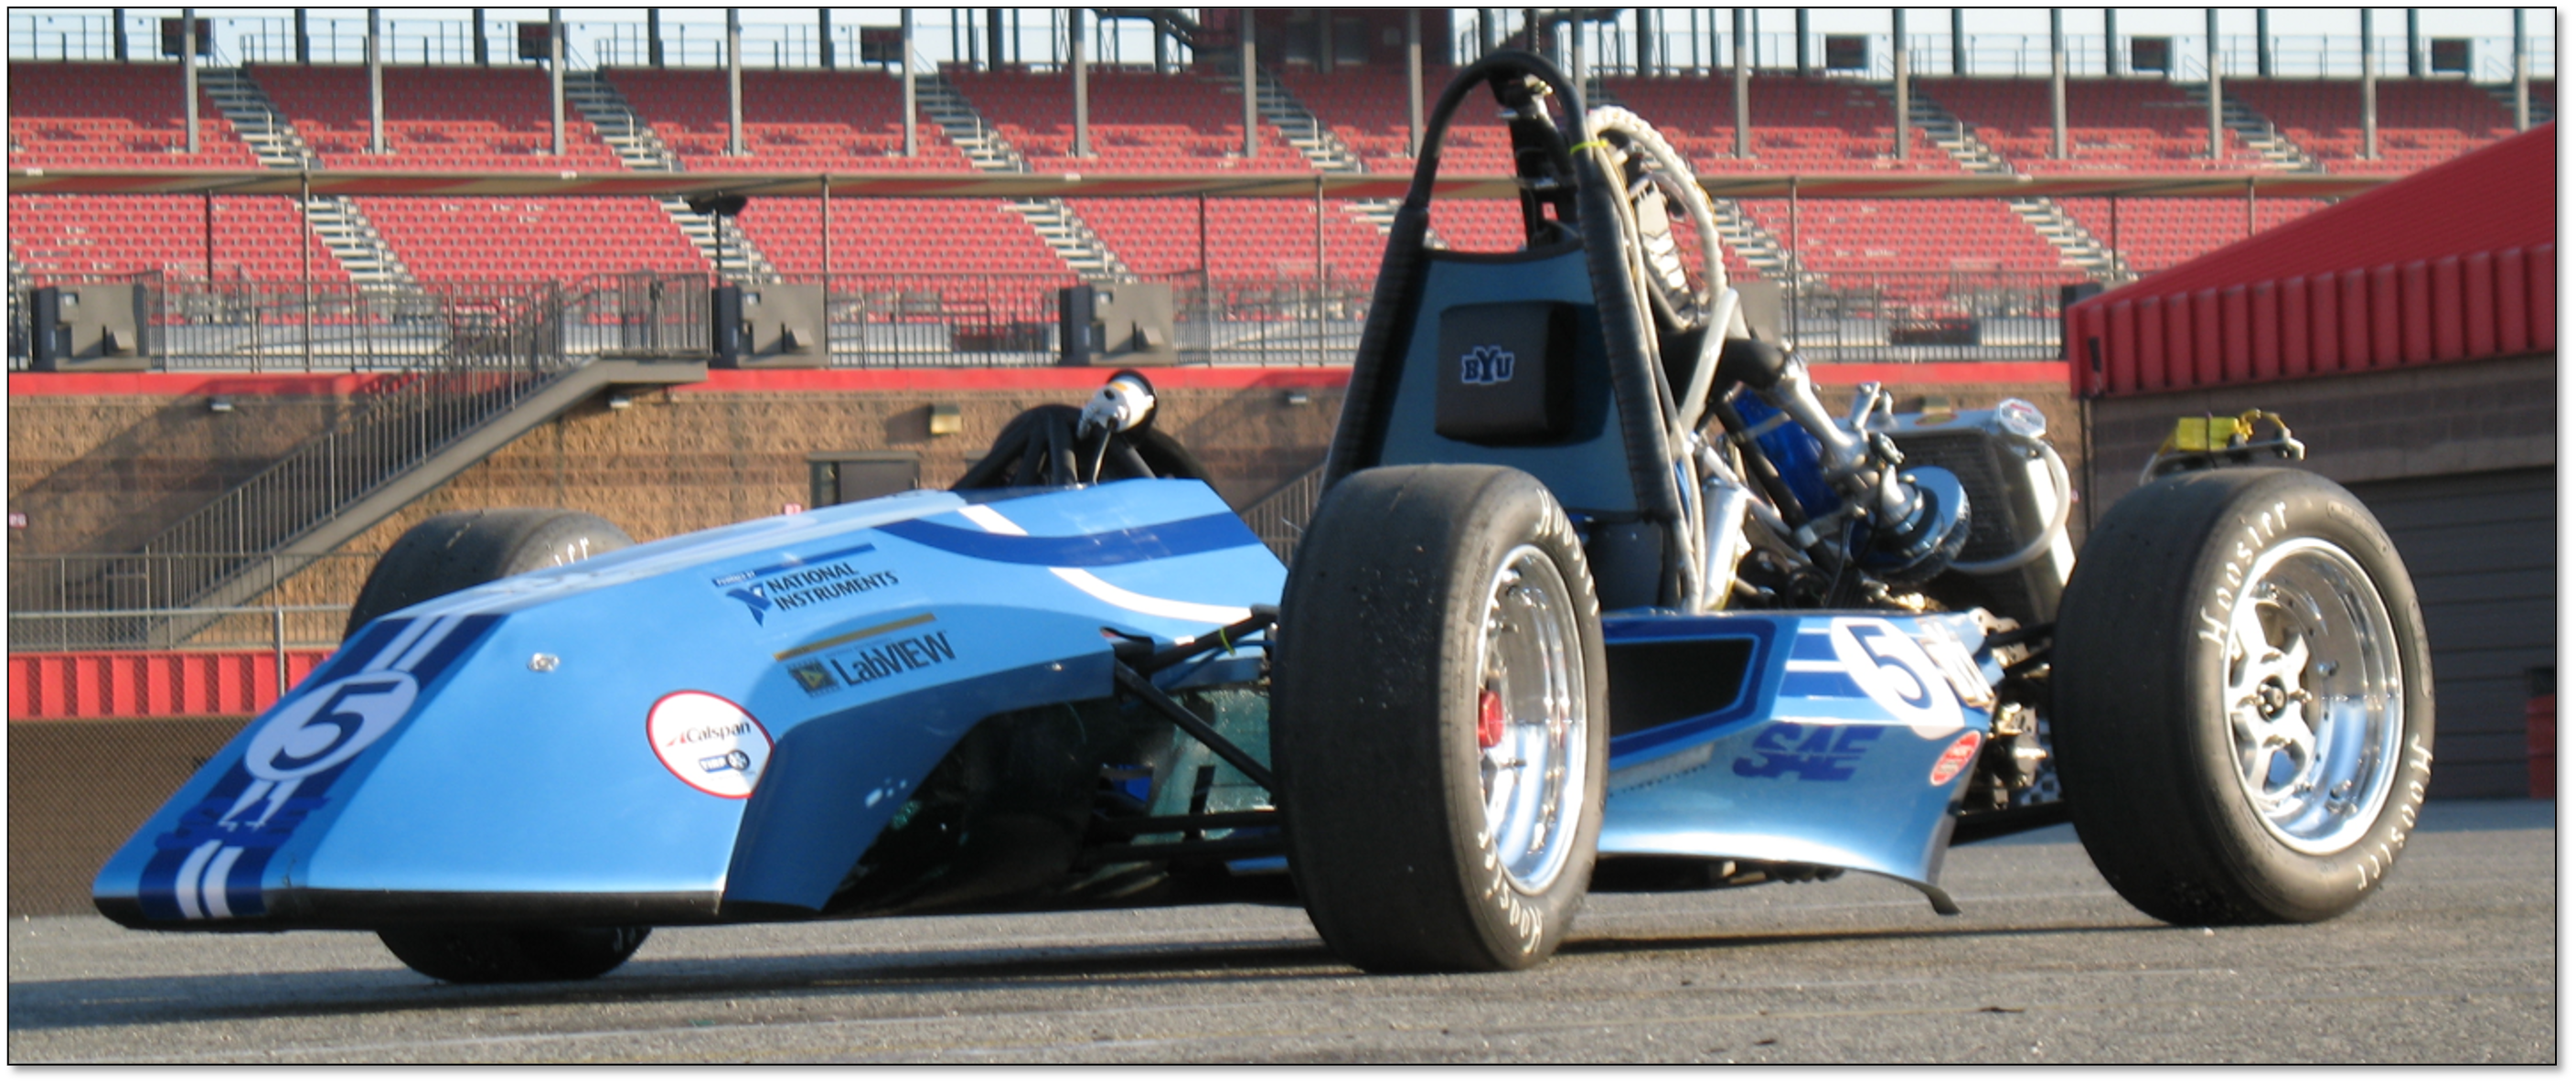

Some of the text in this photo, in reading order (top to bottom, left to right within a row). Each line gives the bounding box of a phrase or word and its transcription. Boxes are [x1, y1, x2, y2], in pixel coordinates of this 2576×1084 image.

[1461, 345, 1514, 385] BYU
[765, 561, 858, 595] NATIONAL
[773, 569, 900, 612] INSTRUMENTS
[2197, 500, 2286, 660] Hoosier
[830, 631, 957, 687] LabVIEW
[1845, 625, 1933, 710] 5
[269, 680, 403, 771] 5
[686, 721, 751, 744] Calspan
[1733, 722, 1886, 782] SAE
[2357, 734, 2433, 891] Hoosier
